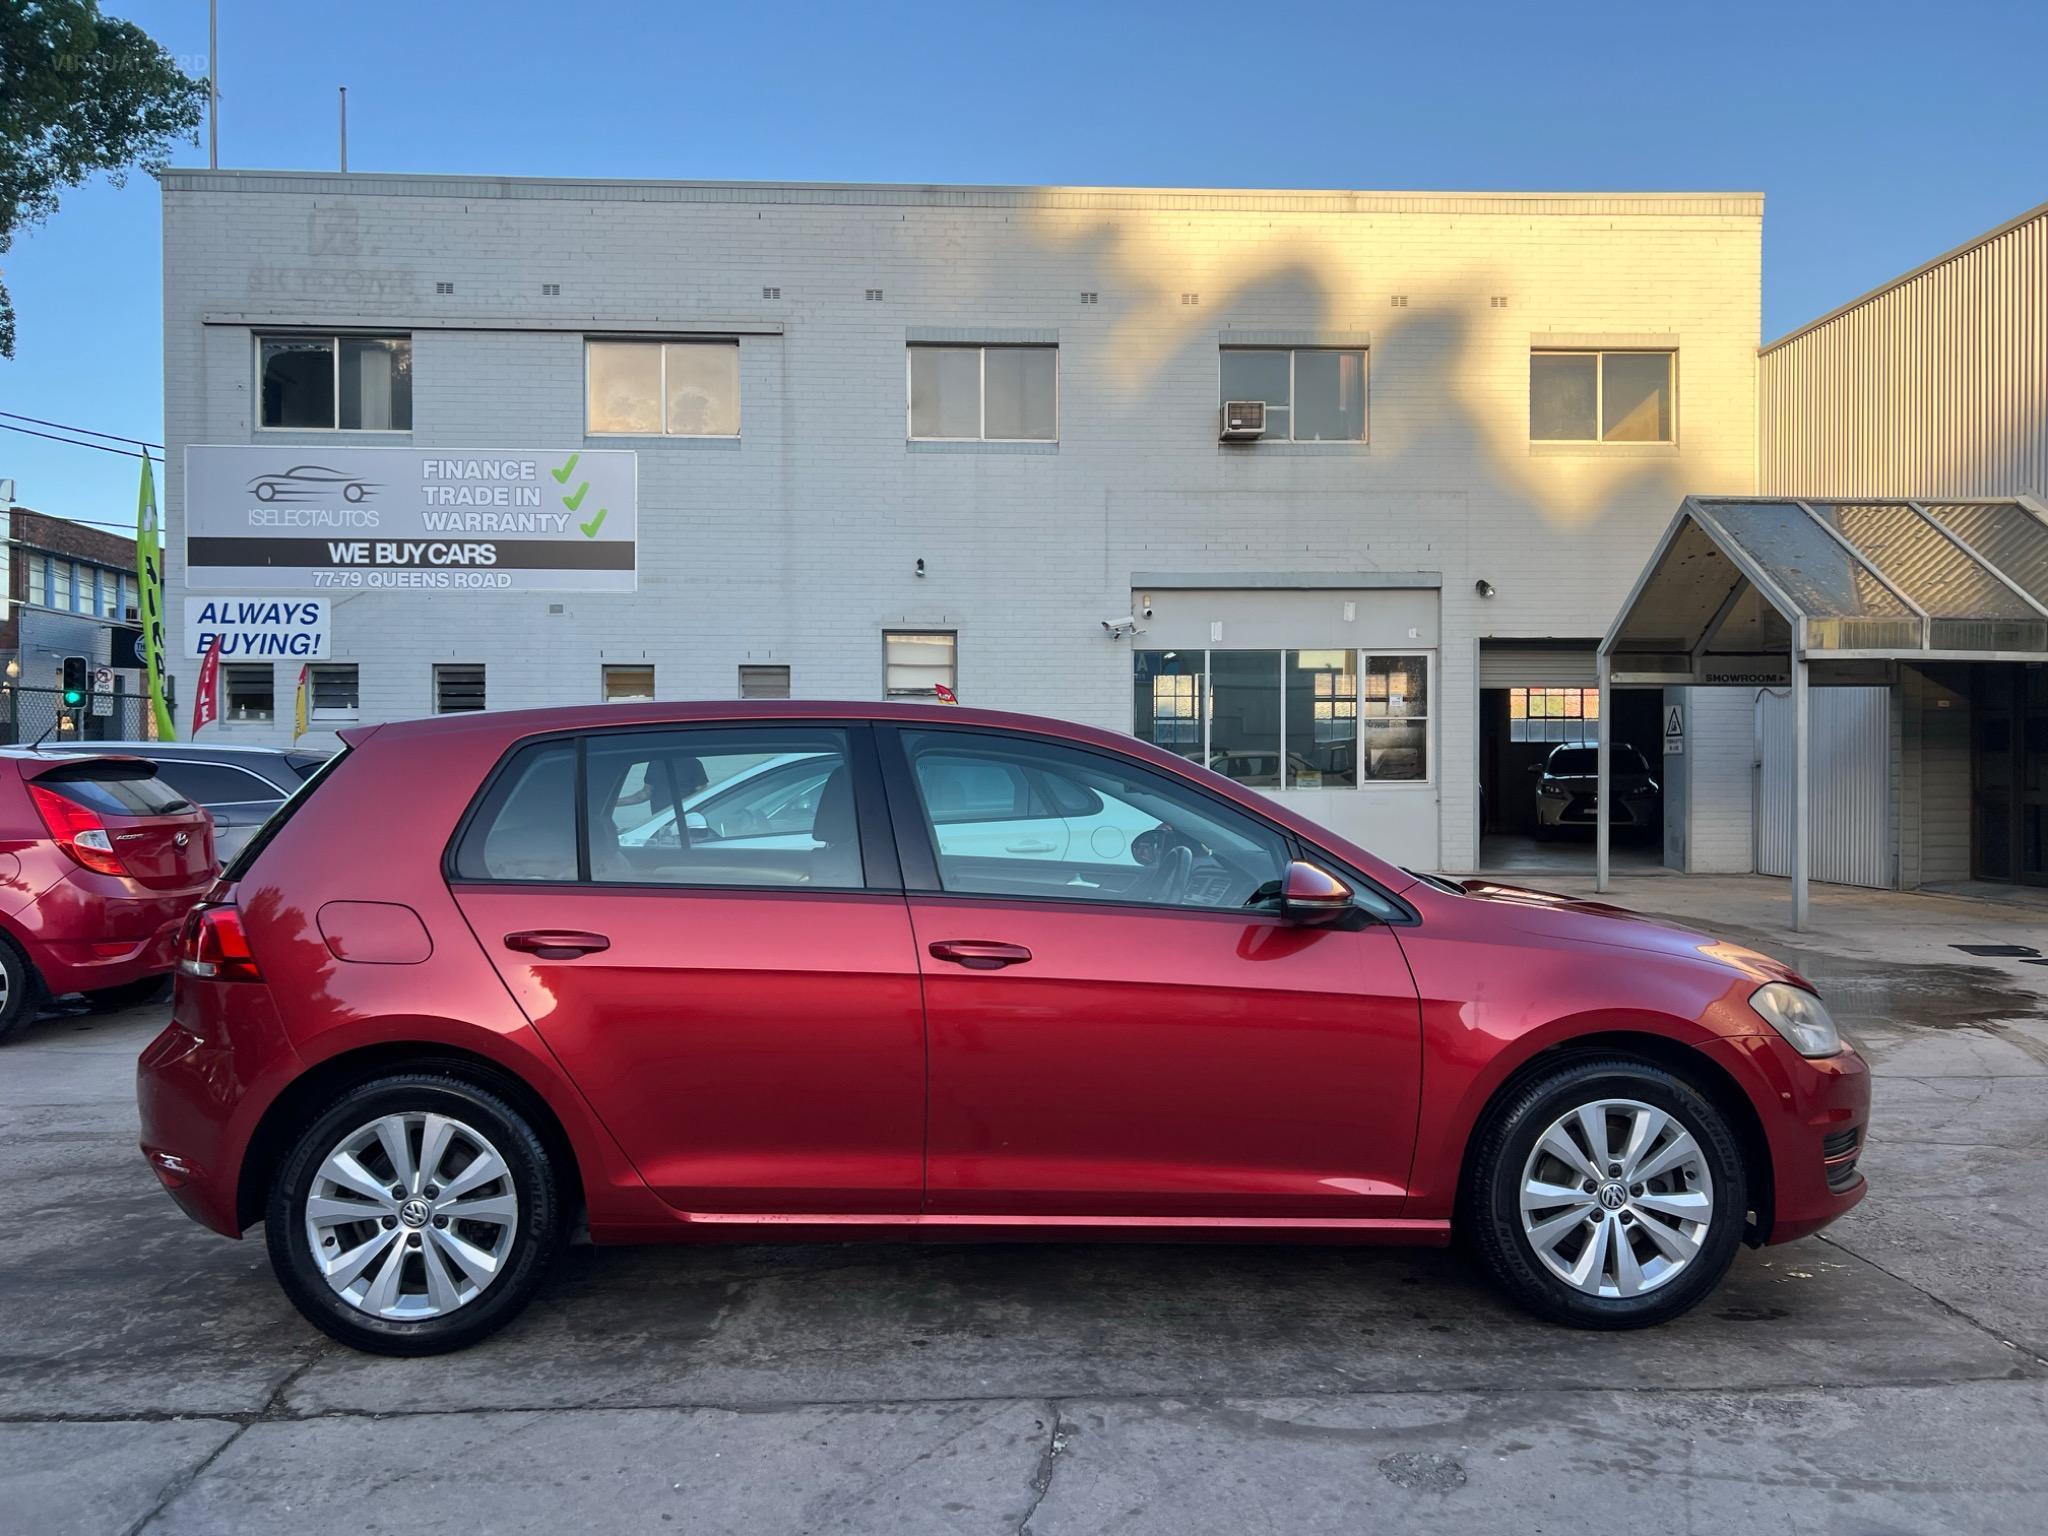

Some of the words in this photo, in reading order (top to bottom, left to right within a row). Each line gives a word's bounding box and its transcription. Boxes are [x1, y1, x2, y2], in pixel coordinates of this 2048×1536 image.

[422, 460, 536, 481] FINANCE
[421, 486, 509, 506] TRADE
[515, 487, 542, 506] IN
[248, 509, 380, 527] ISELECTAUTOS
[421, 511, 571, 533] WARRANTY
[328, 542, 370, 564] WE
[376, 543, 428, 564] BUY
[428, 543, 497, 565] CARS
[312, 571, 363, 588] 77-79
[367, 572, 450, 589] QUEENS
[454, 573, 512, 589] ROAD
[197, 602, 319, 625] ALWAYS
[196, 633, 321, 655] BUYING!
[1706, 674, 1776, 682] SHOWROOM
